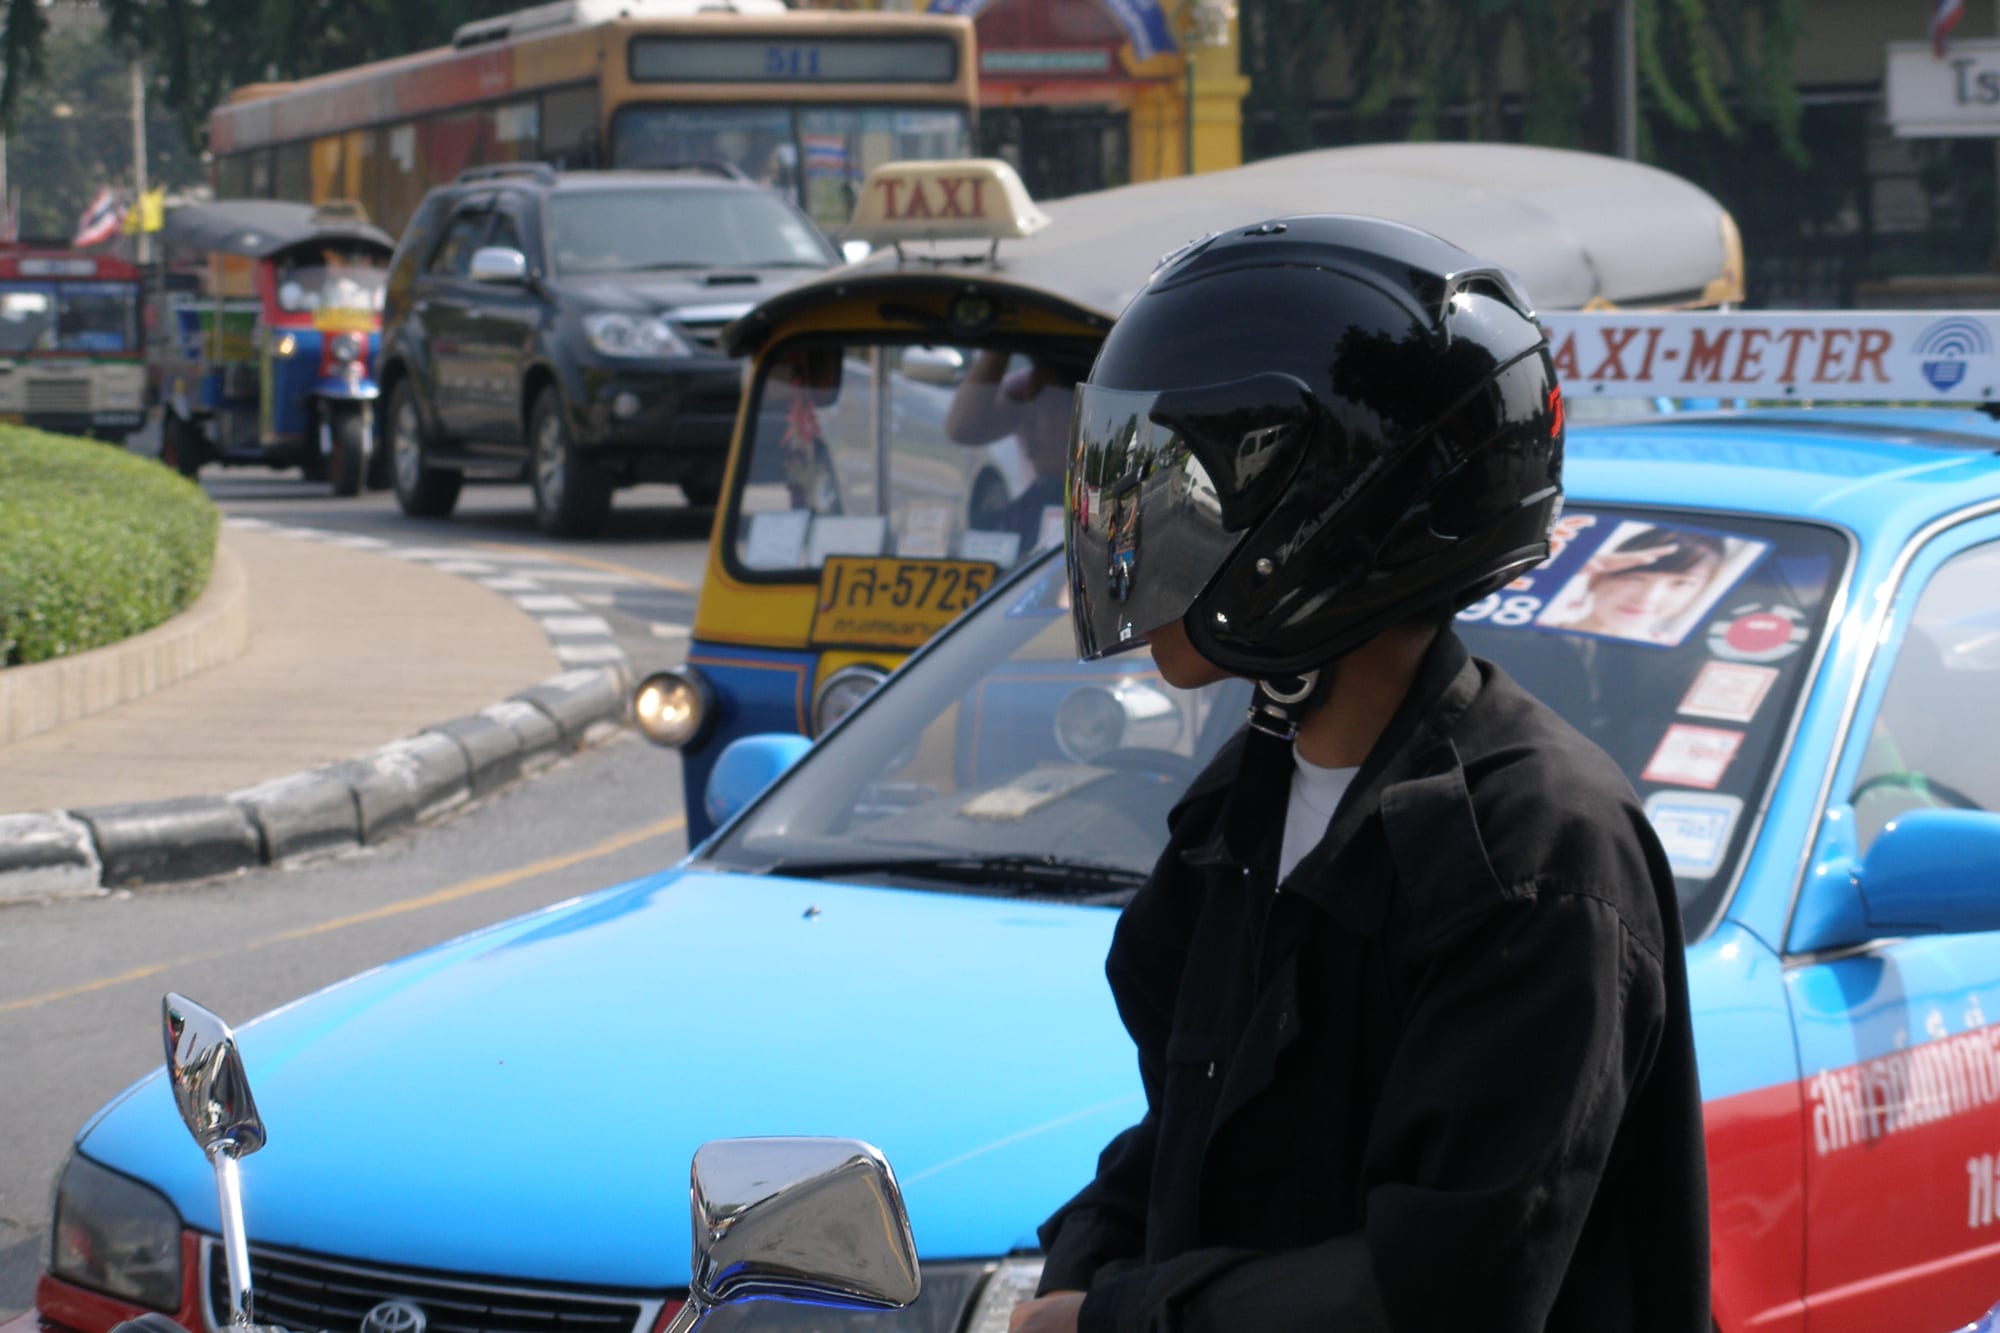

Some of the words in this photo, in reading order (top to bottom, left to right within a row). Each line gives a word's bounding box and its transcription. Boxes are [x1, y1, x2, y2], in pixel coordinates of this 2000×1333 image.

[766, 46, 820, 75] 511
[874, 177, 986, 218] TAXI
[1542, 326, 1893, 383] AXI-METER
